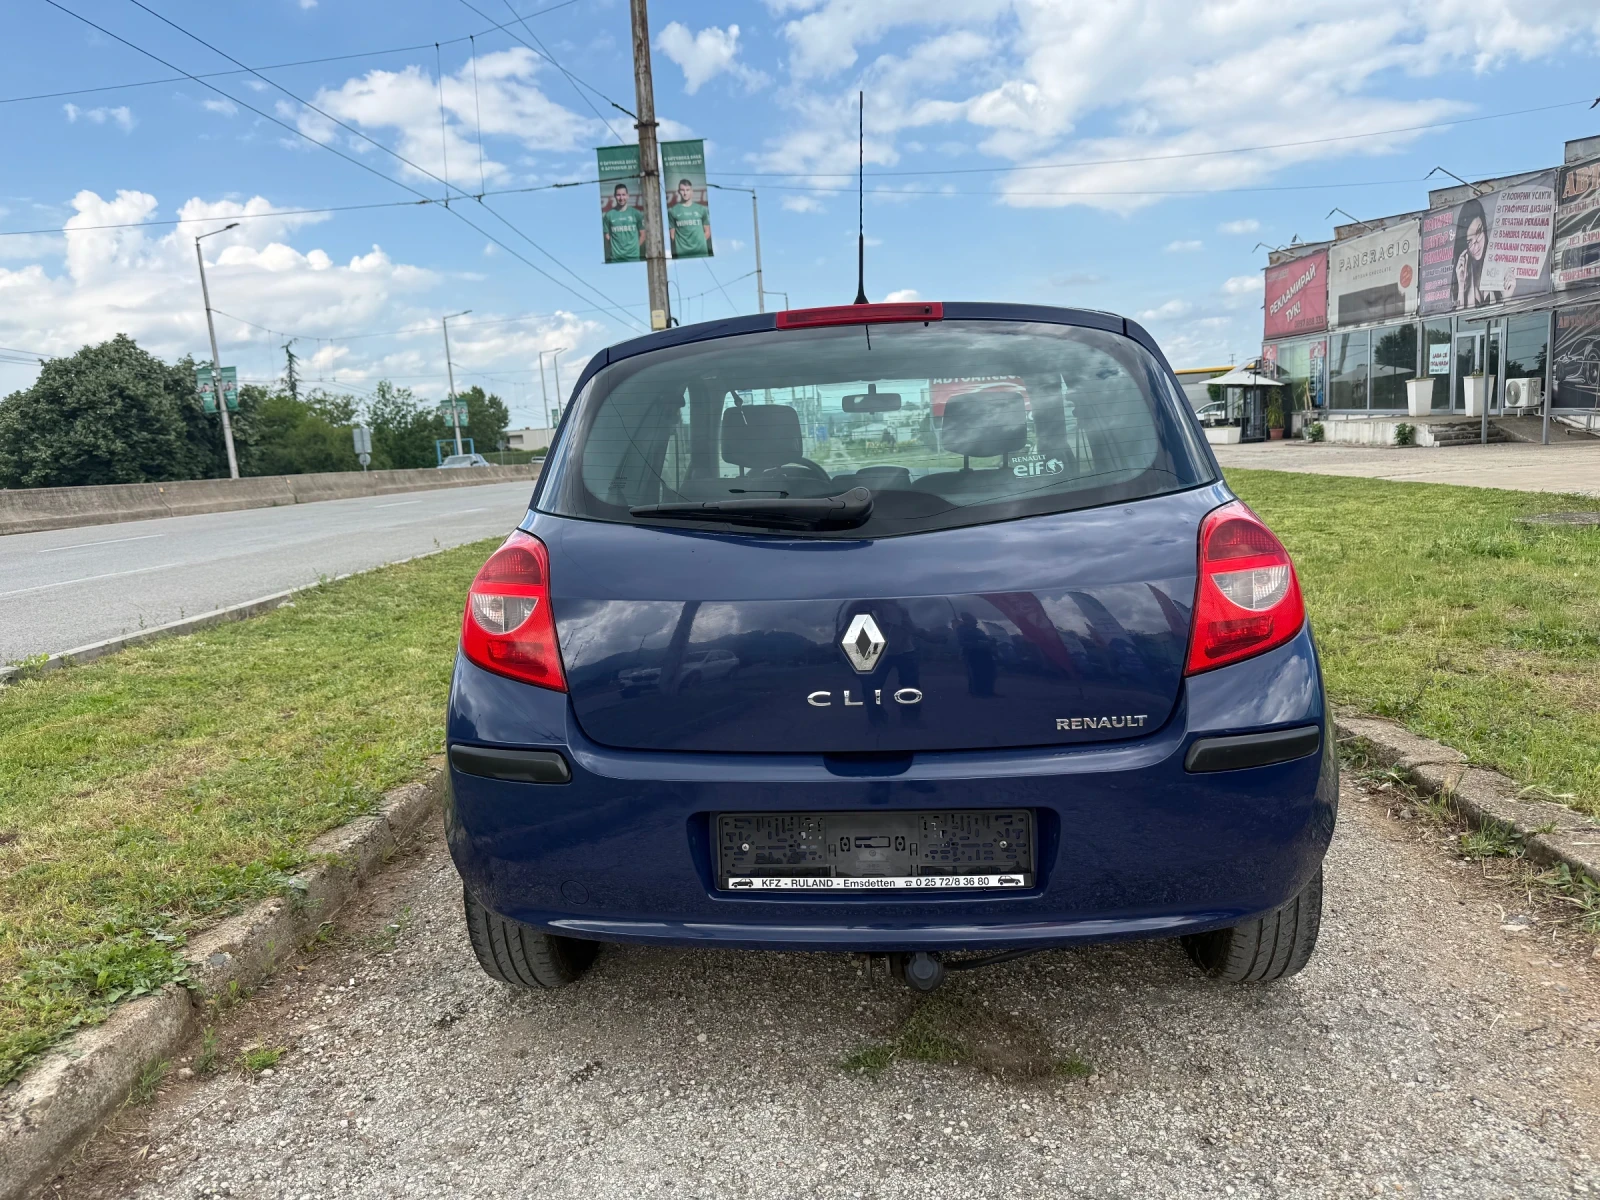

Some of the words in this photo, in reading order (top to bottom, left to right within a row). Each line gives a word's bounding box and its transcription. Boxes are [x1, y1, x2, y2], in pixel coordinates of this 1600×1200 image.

[1532, 191, 1552, 200] УСЛУГИ
[1502, 205, 1529, 213] ГРАФИЧЕН
[1529, 203, 1552, 213] ДИЗАЙН
[1524, 218, 1549, 226] РЕКЛАМА
[1520, 231, 1545, 239] РЕКЛАМА
[1519, 243, 1546, 252] СУВЕНИРИ
[1269, 262, 1316, 316] РЕКЛАМИРАЙ
[1011, 454, 1046, 463] RENAULT
[1013, 461, 1044, 476] elf
[807, 688, 923, 706] CLIO
[1055, 715, 1148, 730] RENAULT
[761, 879, 782, 888] KFZ
[791, 879, 833, 888] RULAND
[843, 878, 896, 888] Emsdetten
[940, 877, 960, 886] 72/8
